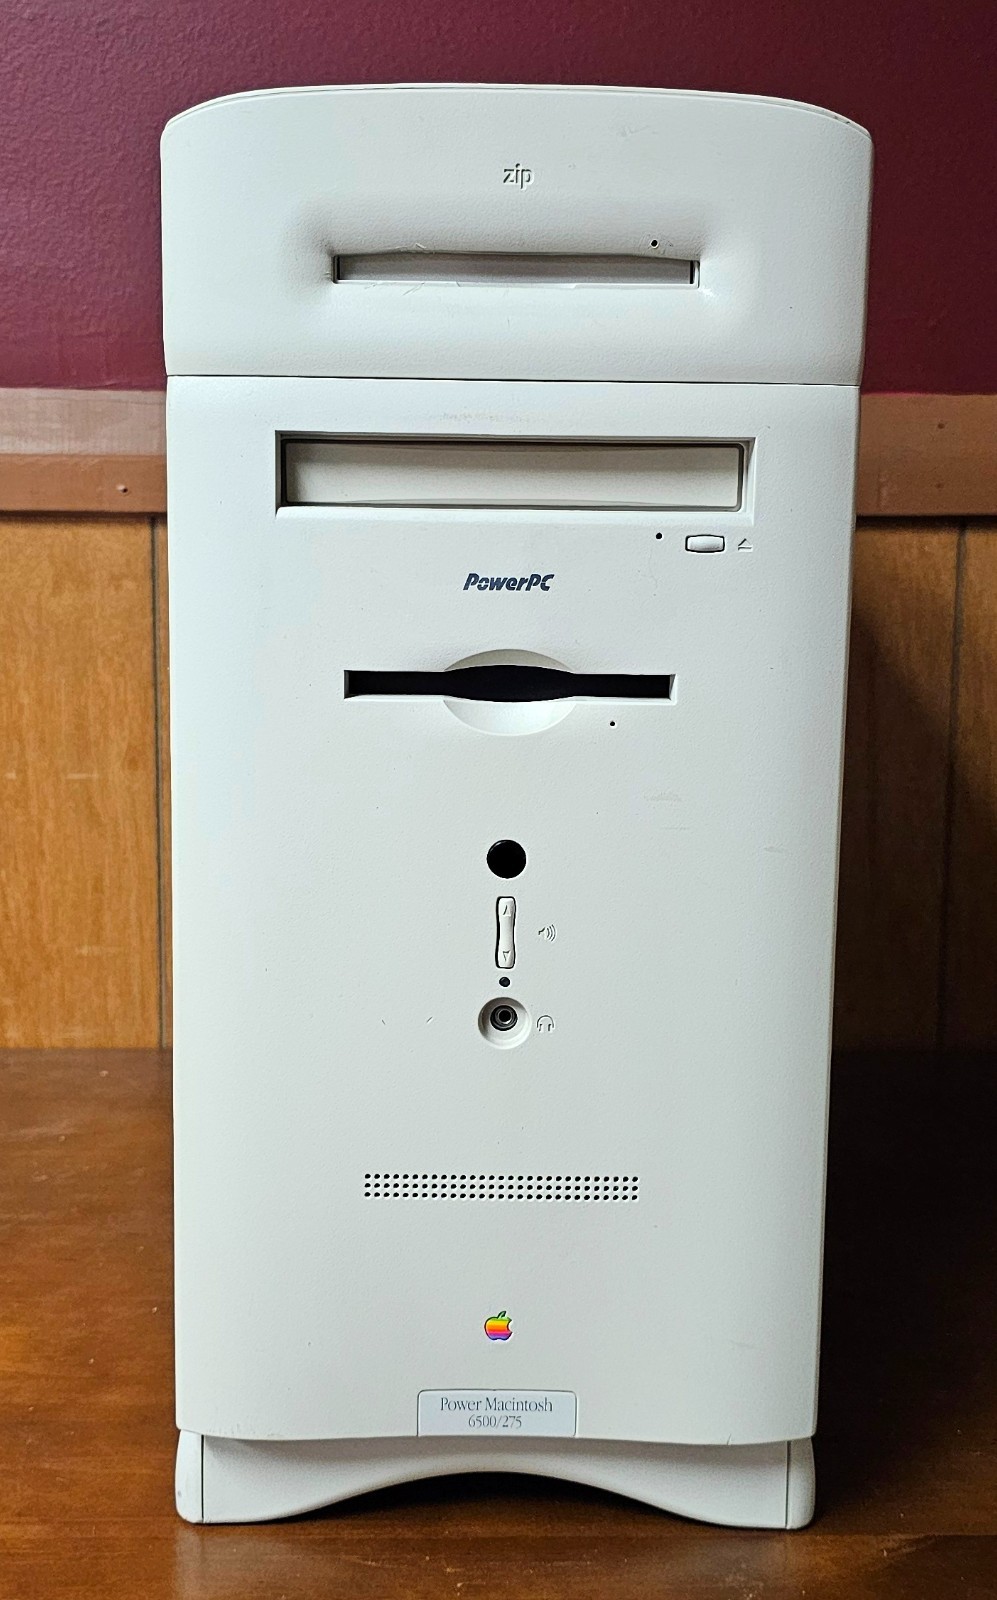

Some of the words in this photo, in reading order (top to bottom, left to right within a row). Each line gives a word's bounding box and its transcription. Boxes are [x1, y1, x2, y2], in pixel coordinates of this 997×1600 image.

[502, 162, 534, 190] zip
[462, 573, 555, 591] PowerPC
[440, 1396, 481, 1411] Power
[485, 1396, 553, 1412] Macintosh
[468, 1413, 522, 1429] 6500/275
